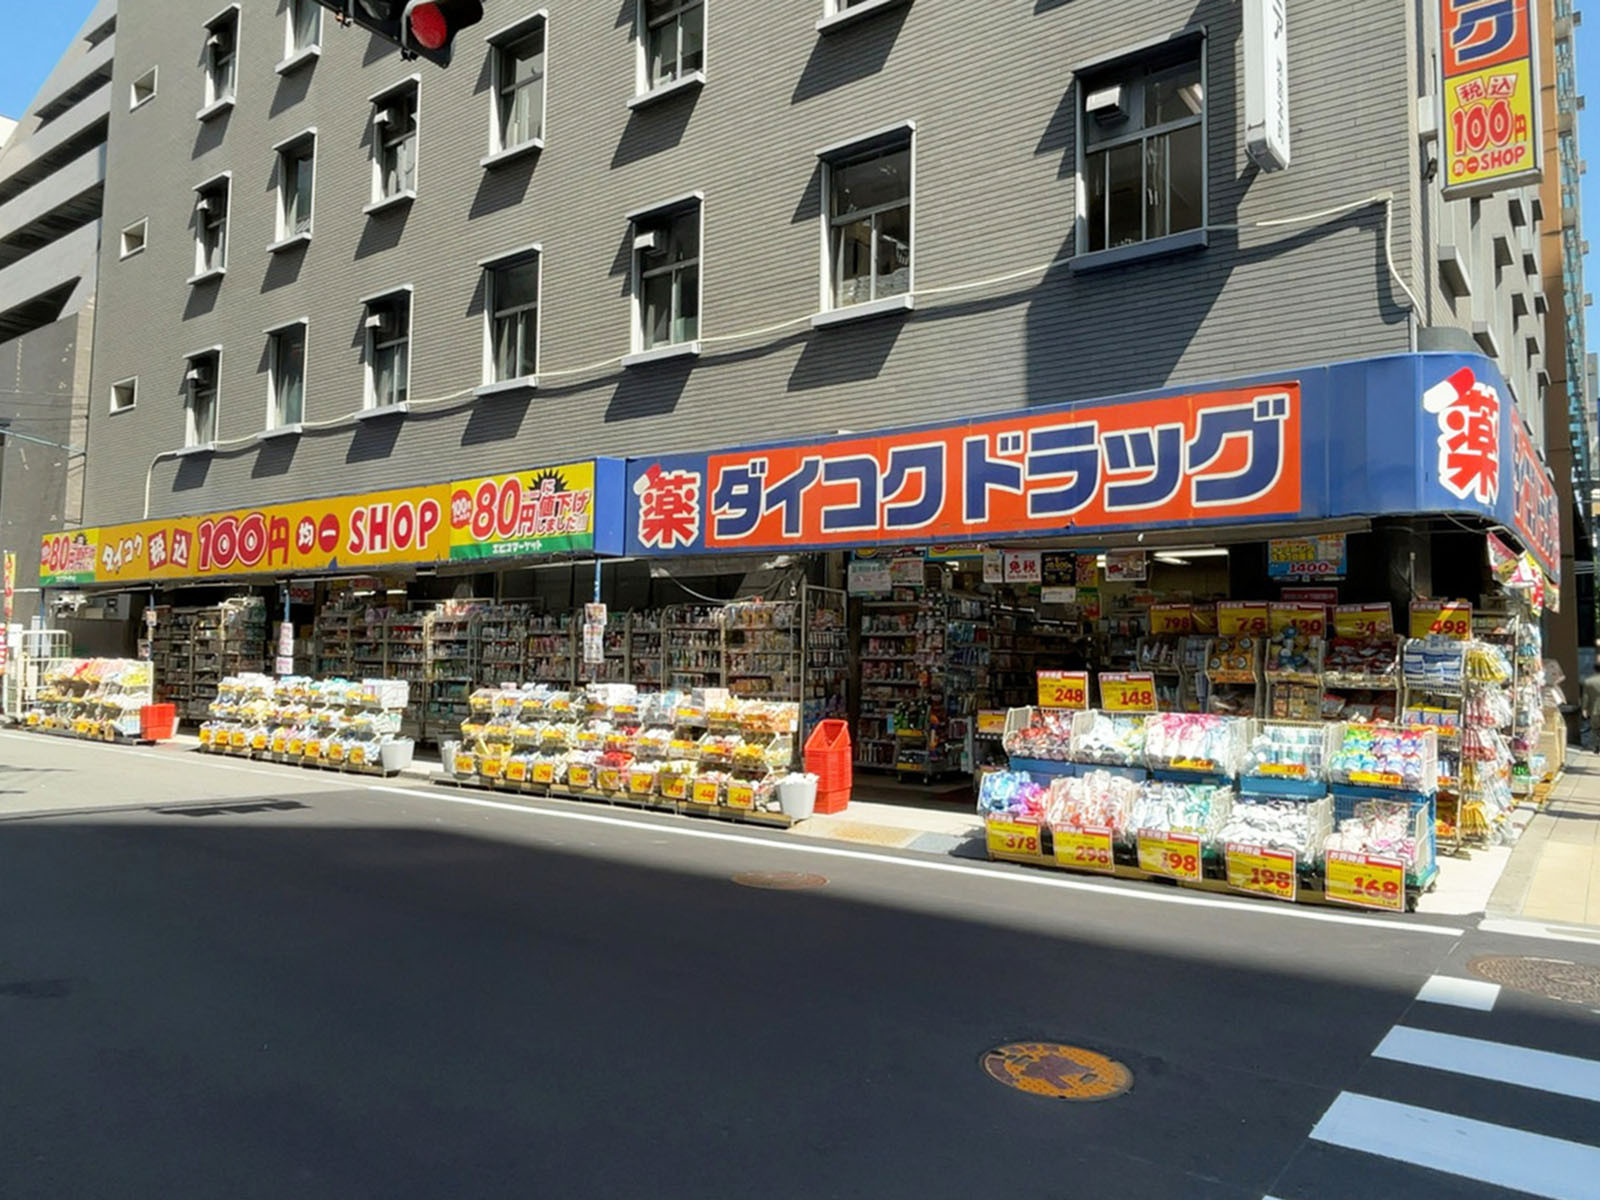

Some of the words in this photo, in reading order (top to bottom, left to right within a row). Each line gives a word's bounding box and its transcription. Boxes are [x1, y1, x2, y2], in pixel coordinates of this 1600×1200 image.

[1459, 77, 1512, 102] 税込
[1453, 100, 1528, 156] 100円
[1480, 146, 1525, 171] SHOP
[1424, 366, 1499, 507] 薬
[633, 463, 700, 548] 薬
[711, 393, 1290, 541] ダイコクドラッグ
[148, 530, 192, 570] 税込
[199, 513, 289, 571] 100円
[347, 497, 441, 556] SHOP
[1429, 620, 1467, 634] 498
[1055, 688, 1084, 702] 248
[1120, 691, 1152, 705] 148
[1006, 834, 1037, 850] 378
[1251, 868, 1290, 890] 198
[1352, 877, 1399, 900] 168
